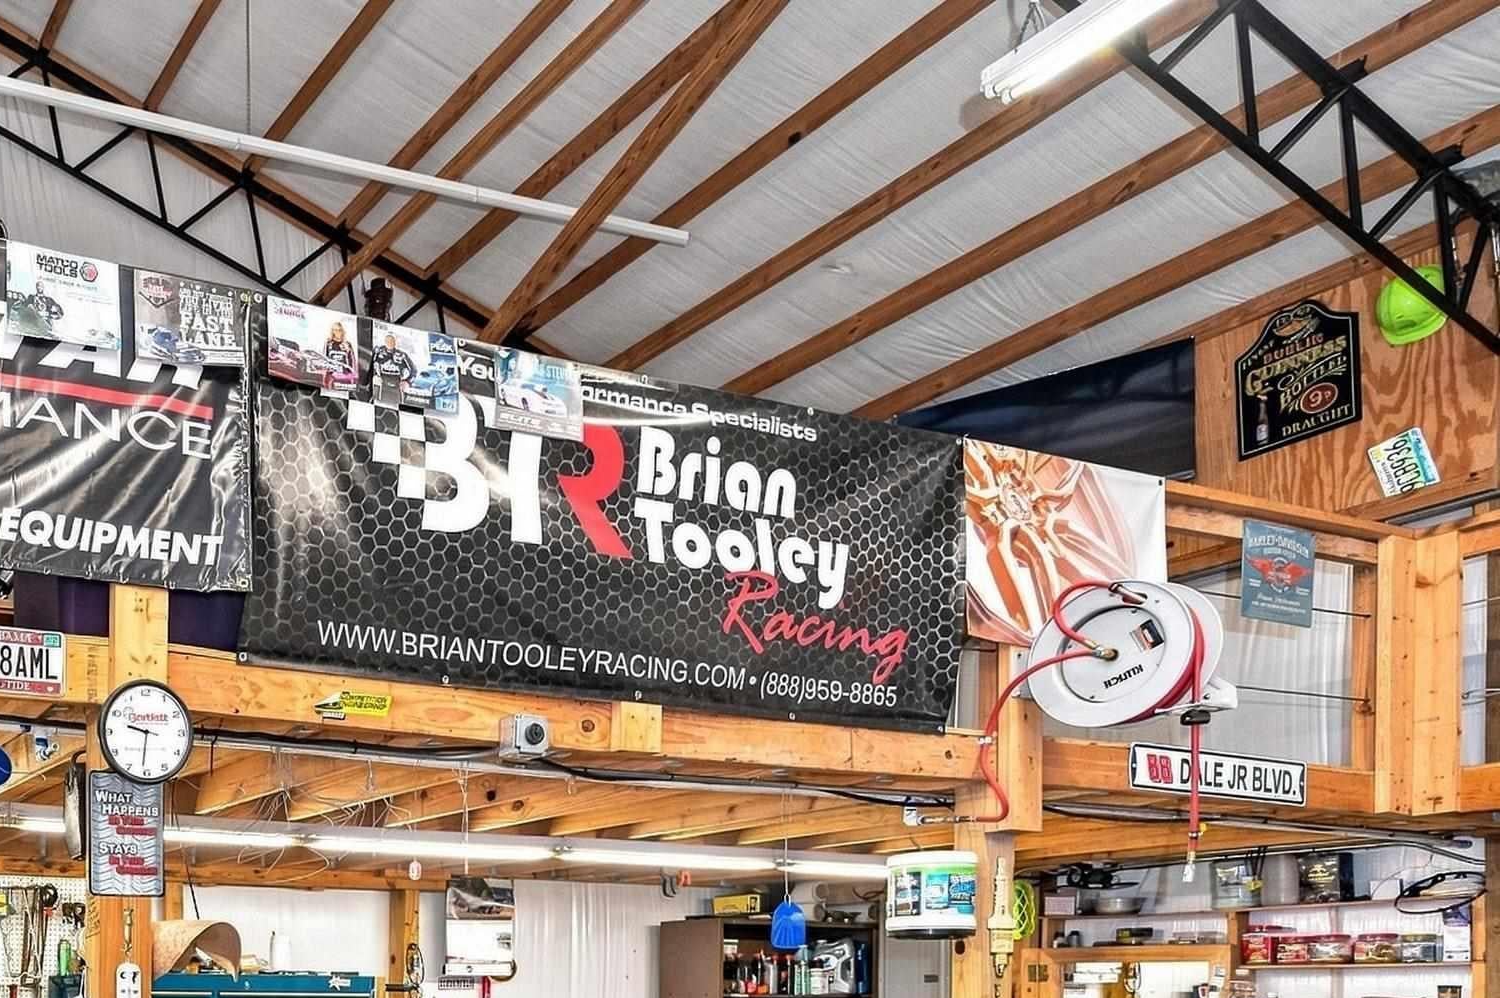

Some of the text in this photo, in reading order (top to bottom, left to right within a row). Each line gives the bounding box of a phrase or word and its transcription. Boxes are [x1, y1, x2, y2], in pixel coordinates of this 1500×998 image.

[36, 254, 79, 270] MATCO
[37, 261, 78, 279] TOOLS
[180, 313, 234, 334] FAST
[180, 332, 237, 347] LANE
[1245, 335, 1347, 396] GUINNESS
[581, 384, 687, 414] ormance
[690, 402, 817, 443] Specialists
[1282, 403, 1351, 437] DRAUGHT
[637, 426, 797, 519] Brian
[0, 507, 224, 566] EQUIPMENT
[634, 497, 850, 609] Tooley
[722, 570, 909, 685] Racing
[317, 619, 898, 708] WWW.BRIANTOOLEYRACING.COM (888)959-8865
[4, 679, 31, 691] TIDE
[1146, 754, 1297, 796] 88 DLE JR BLVD.
[95, 790, 132, 803] WHAT
[102, 803, 159, 816] HAPPENS
[99, 842, 137, 854] STAYS
